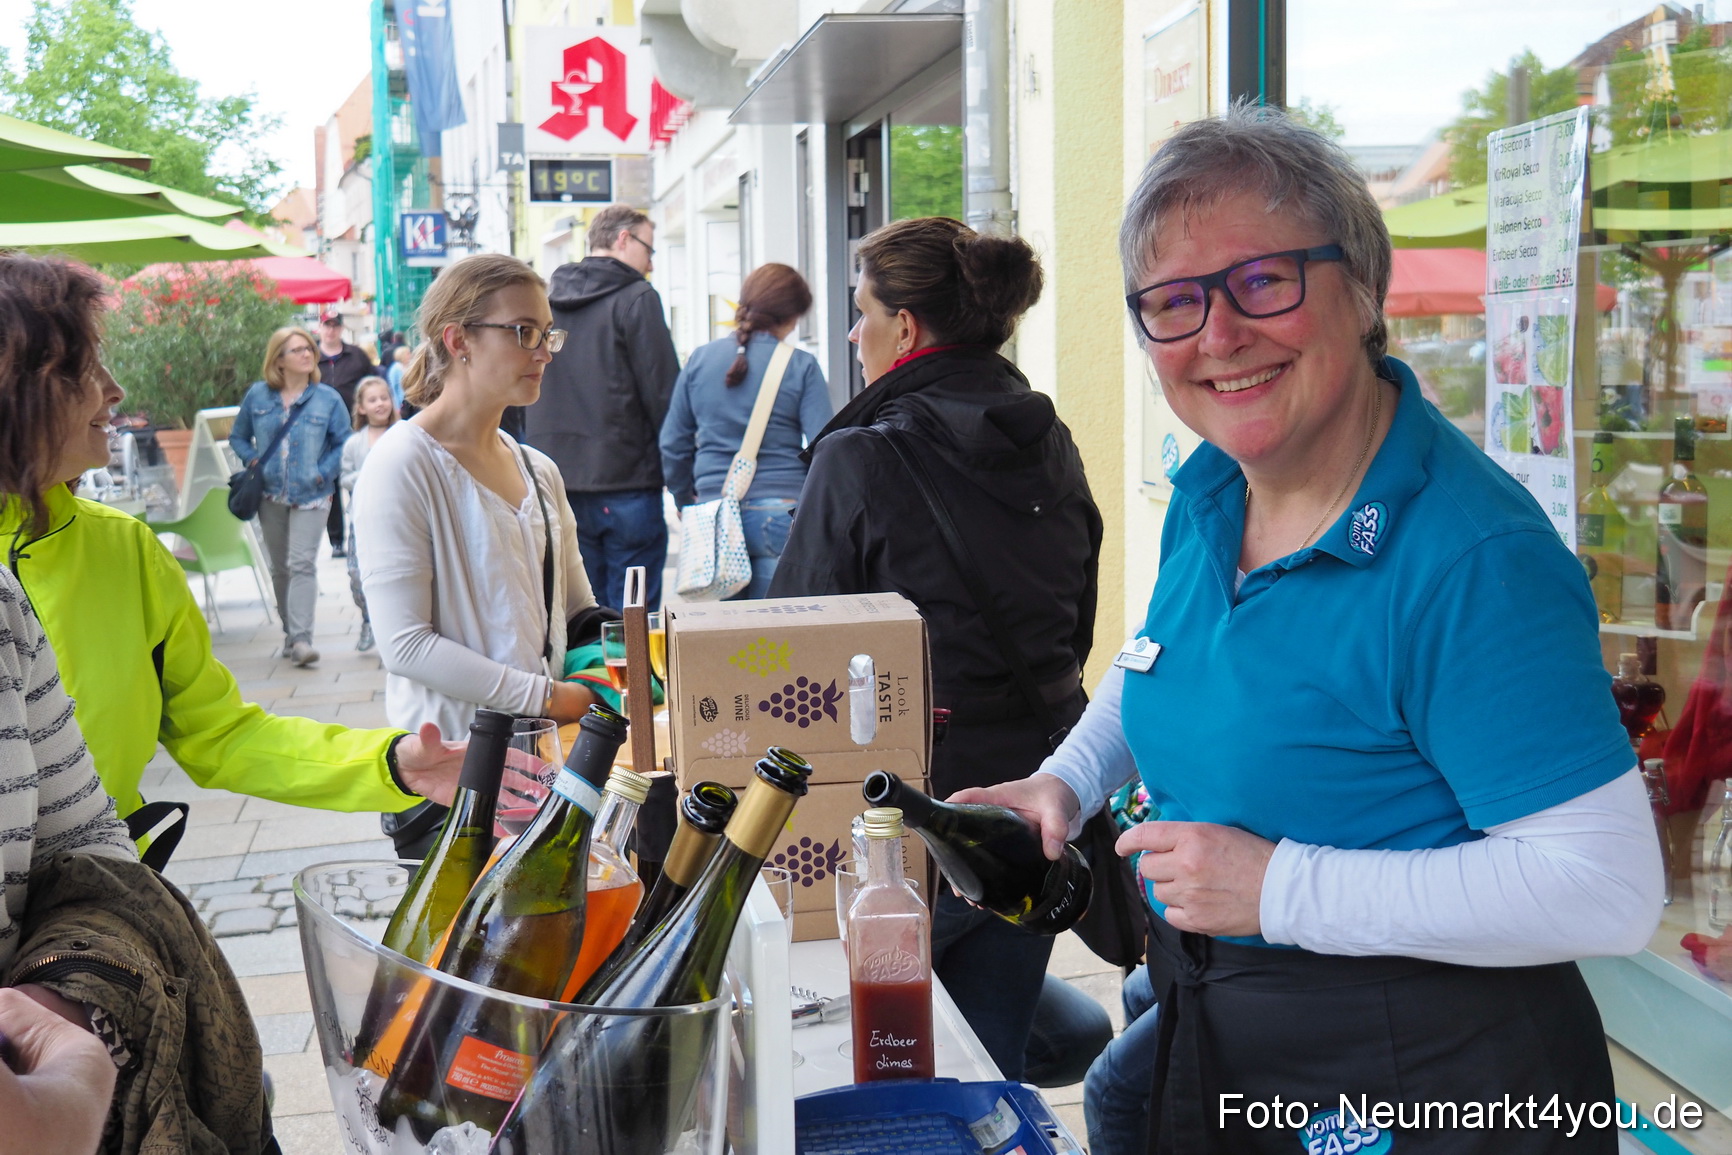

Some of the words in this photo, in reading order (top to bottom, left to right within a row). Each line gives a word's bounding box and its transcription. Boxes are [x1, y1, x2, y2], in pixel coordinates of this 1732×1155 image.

[1522, 162, 1540, 176] Secco
[538, 170, 600, 192] 19°C
[1494, 192, 1523, 208] Maracuja
[1525, 189, 1542, 203] Secco
[1494, 220, 1522, 234] Melonen
[1523, 217, 1542, 230] Secco
[1492, 248, 1518, 261] Erdbeer
[1519, 245, 1538, 258] Secco
[1513, 275, 1529, 288] oder
[1555, 267, 1572, 285] 3,50€
[1552, 474, 1567, 489] 3,00€
[1552, 502, 1568, 518] 3,00€
[1360, 504, 1379, 555] FASS
[878, 671, 892, 723] TASTE
[897, 675, 910, 716] Look
[700, 700, 714, 722] FASS
[734, 694, 744, 721] WINE
[869, 1030, 918, 1047] Erdbeer
[1304, 1113, 1341, 1139] vom
